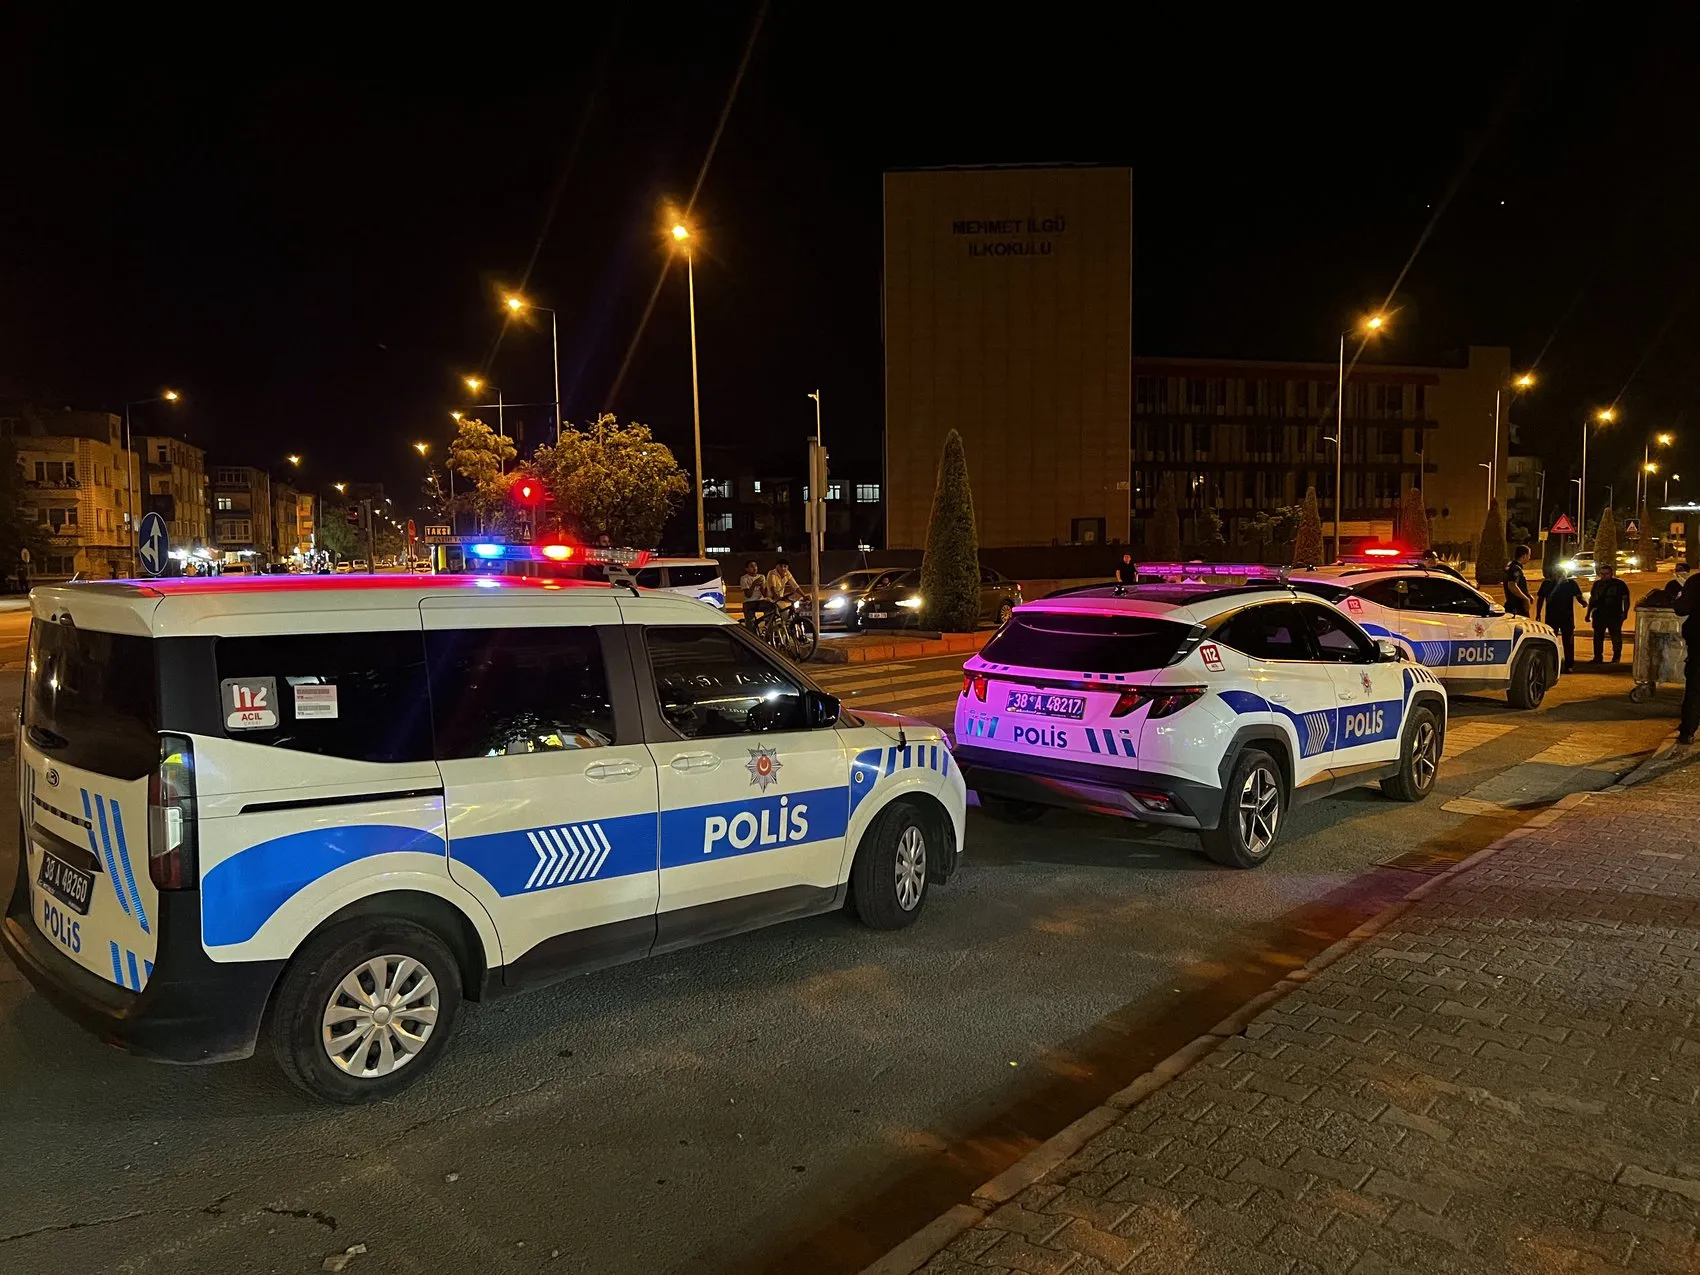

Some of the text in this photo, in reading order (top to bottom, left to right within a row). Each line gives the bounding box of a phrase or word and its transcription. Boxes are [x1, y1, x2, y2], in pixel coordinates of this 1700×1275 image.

[953, 220, 1023, 234] MEHMET
[1349, 600, 1360, 609] 112
[1203, 648, 1219, 662] 112
[1457, 642, 1495, 662] POLİS
[232, 684, 267, 708] 112
[1013, 694, 1028, 708] 38
[1034, 695, 1042, 711] A
[1046, 697, 1082, 714] 48217
[1345, 704, 1384, 739] POLİS
[1014, 724, 1068, 748] POLİS
[703, 796, 808, 854] POLİS
[45, 857, 55, 880] 38
[55, 864, 61, 887] A
[62, 868, 88, 903] 48260
[44, 899, 80, 953] POLİS
